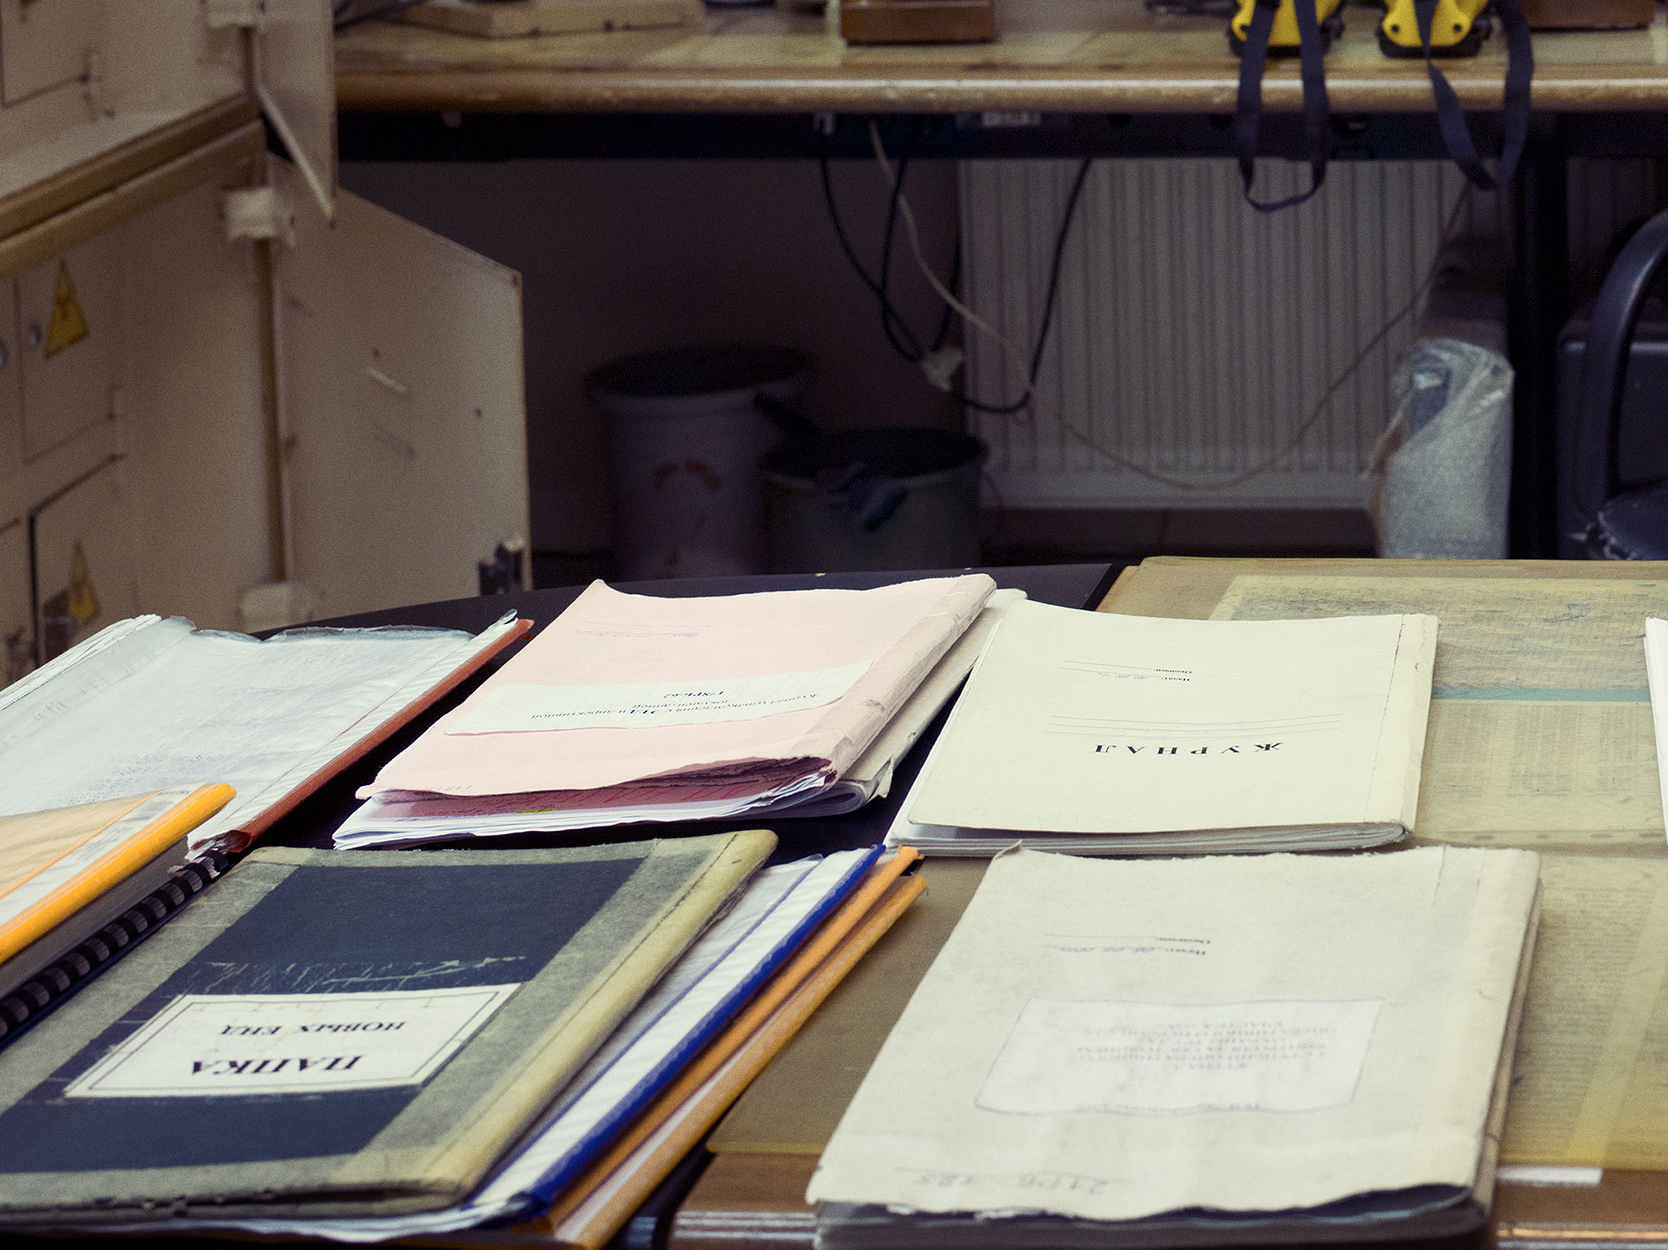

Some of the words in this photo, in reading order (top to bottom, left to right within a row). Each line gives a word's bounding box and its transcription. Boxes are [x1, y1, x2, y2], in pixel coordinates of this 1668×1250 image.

[1090, 742, 1284, 755] ЖУРНАЛ
[298, 1021, 407, 1033] НОВЫХ
[190, 1054, 365, 1075] ПАПКА
